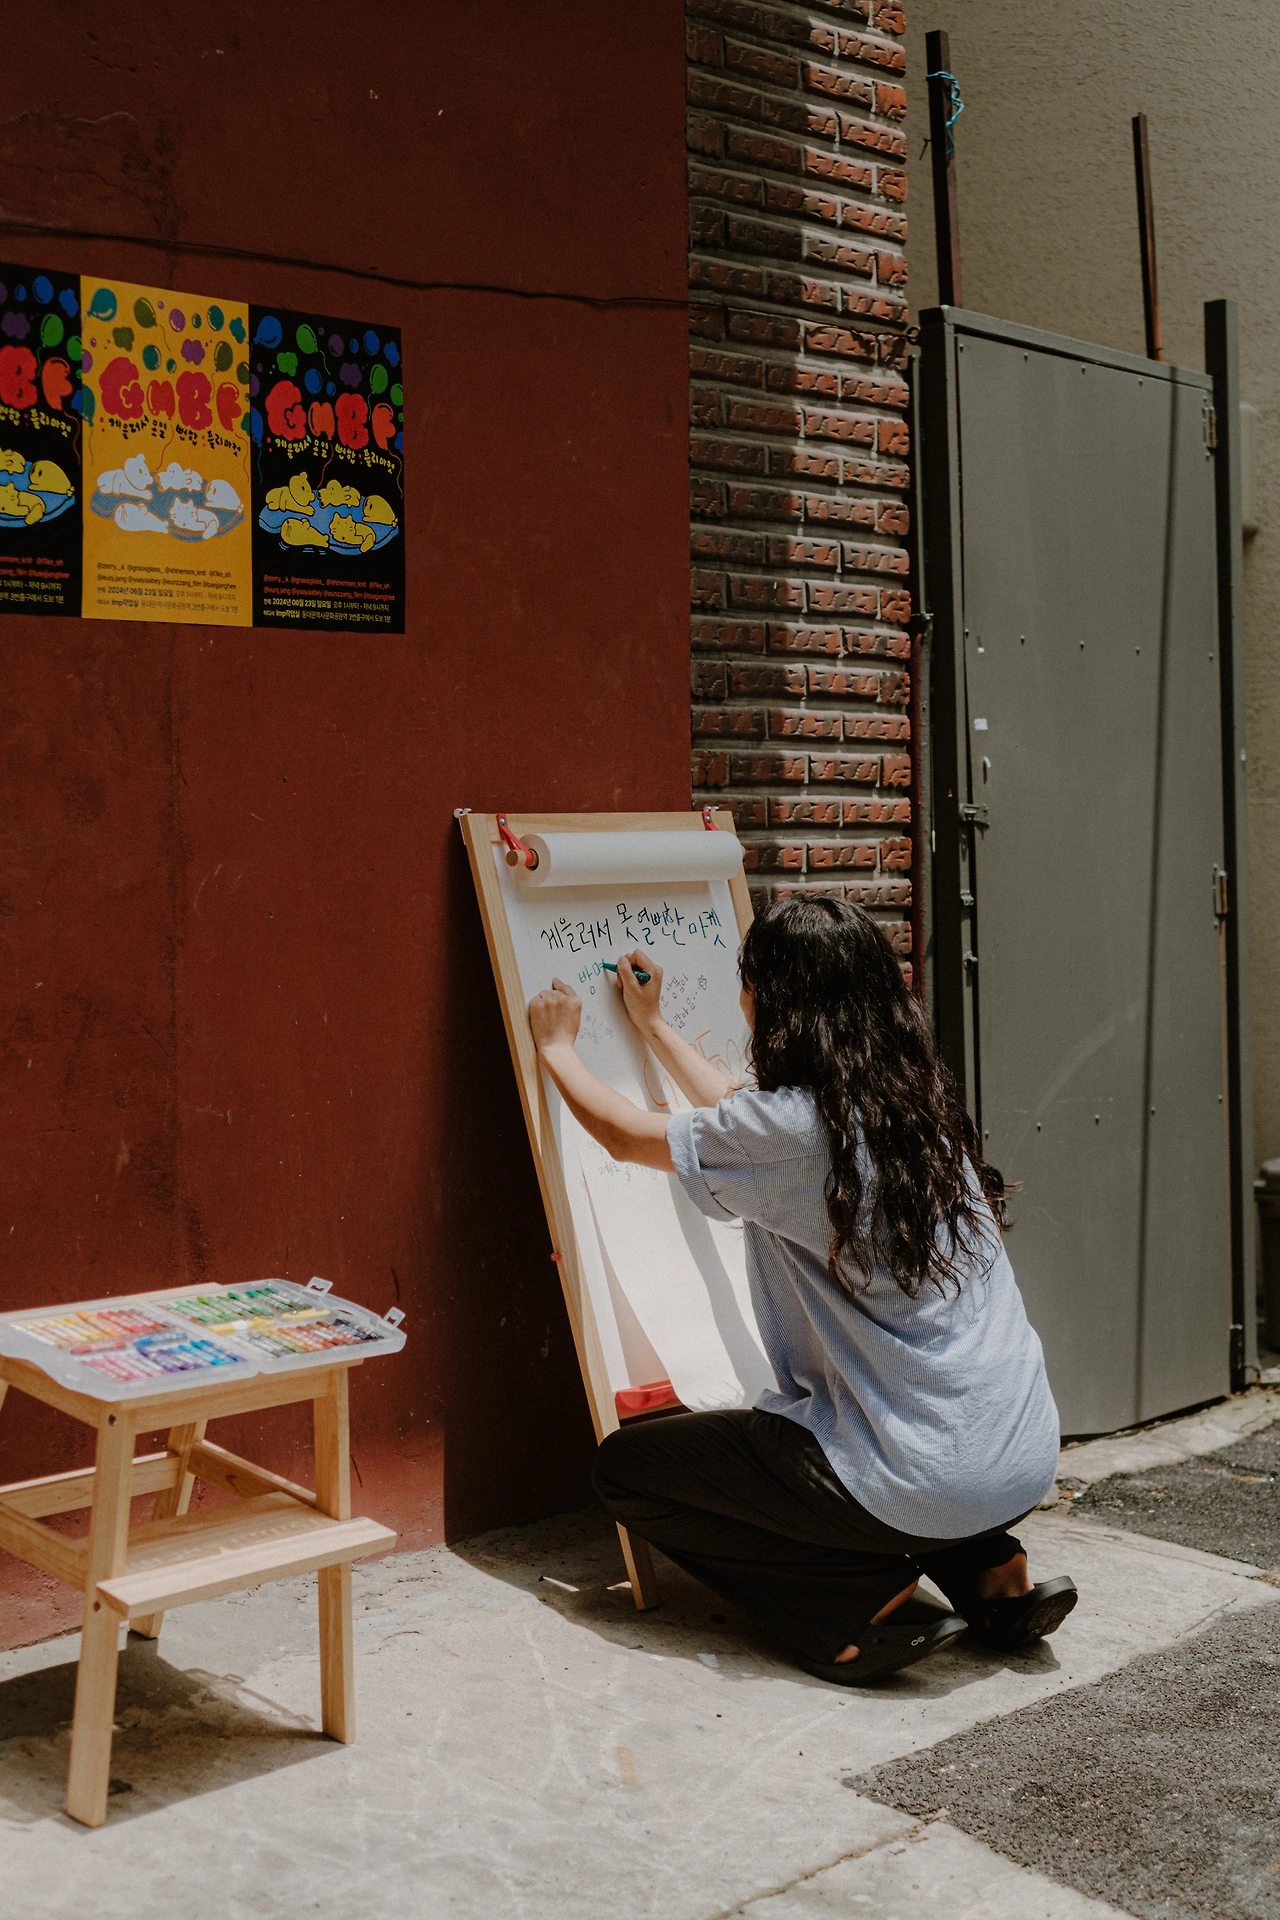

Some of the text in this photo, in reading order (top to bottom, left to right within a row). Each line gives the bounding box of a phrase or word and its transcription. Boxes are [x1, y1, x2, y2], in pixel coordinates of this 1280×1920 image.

[30, 408, 71, 438] 플리마켓
[109, 415, 149, 440] 게을러서
[207, 430, 241, 457] 플리마켓
[275, 434, 312, 459] 게을러서
[364, 448, 395, 474] 플리마켓
[107, 586, 129, 595] 2024년
[129, 587, 143, 596] 06월
[144, 588, 157, 597] 23일
[272, 598, 291, 606] 2024년
[291, 599, 304, 607] 06월
[304, 599, 316, 608] 23일
[540, 917, 613, 953] 게을러서
[689, 908, 727, 948] 마켓
